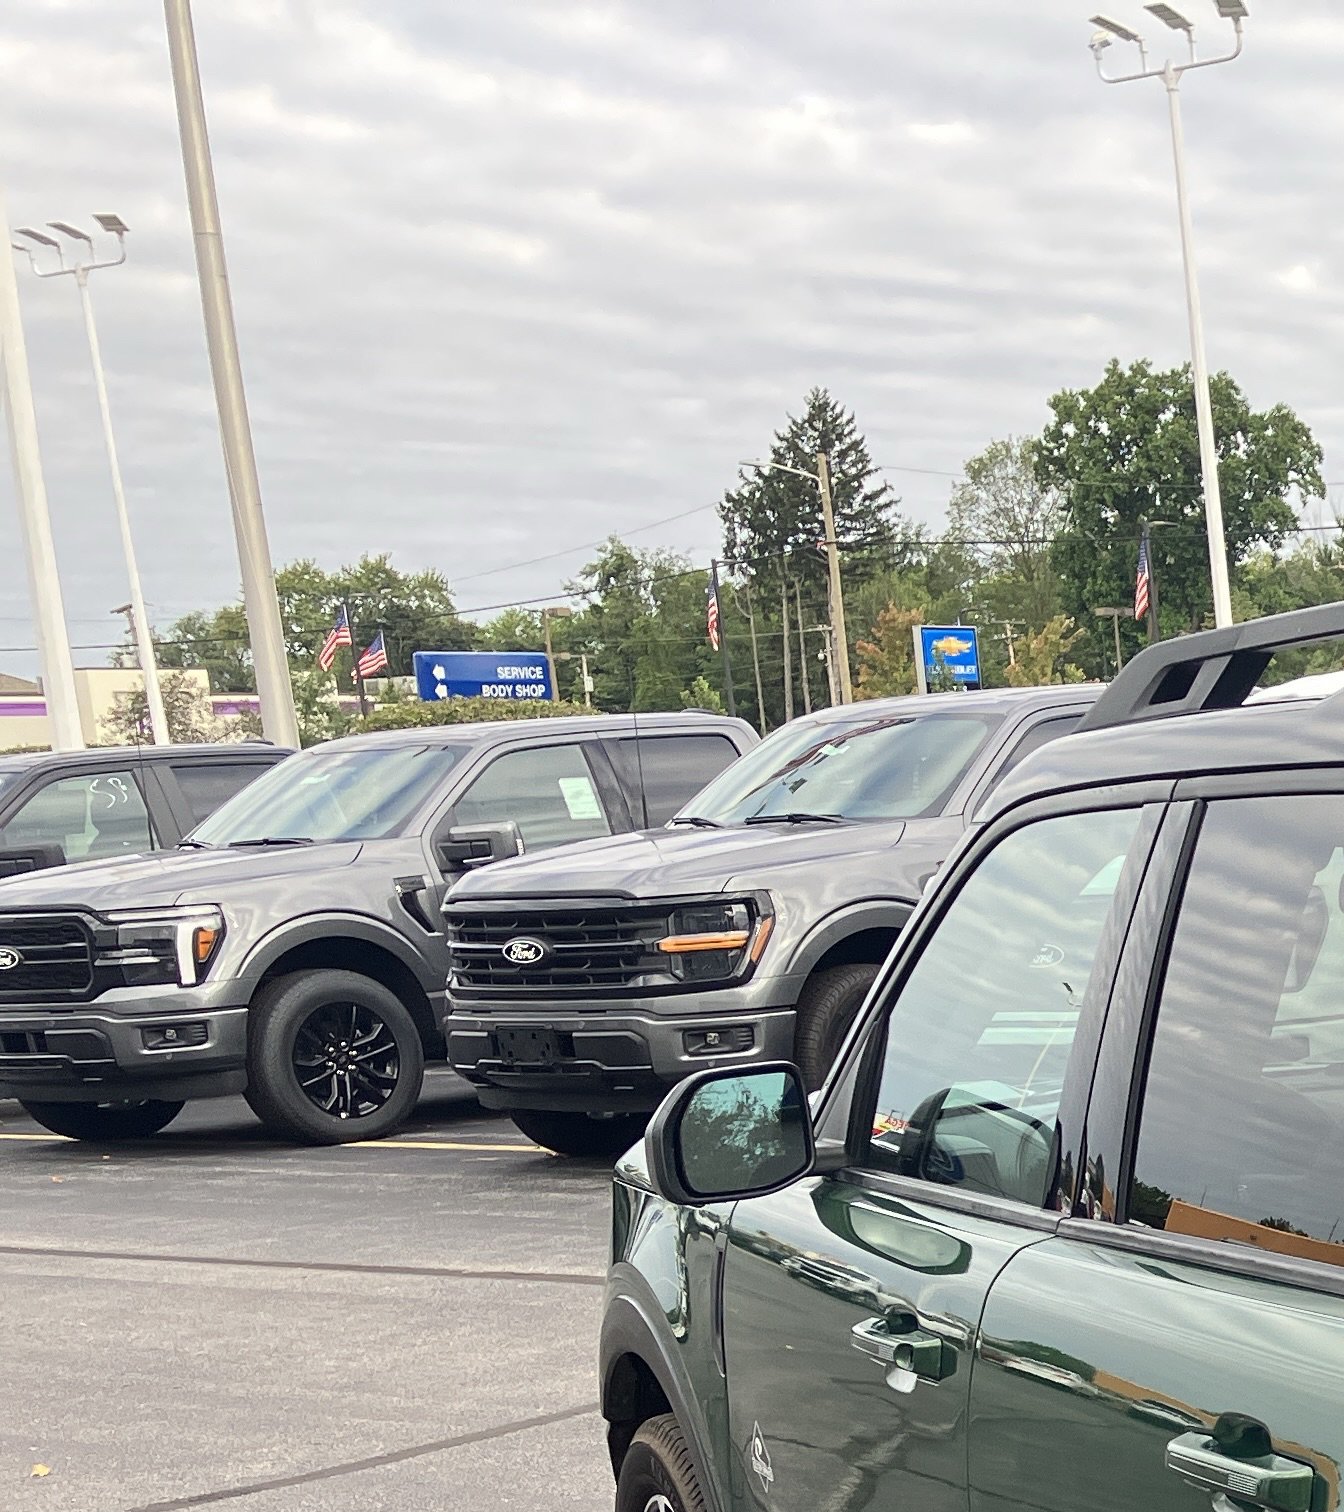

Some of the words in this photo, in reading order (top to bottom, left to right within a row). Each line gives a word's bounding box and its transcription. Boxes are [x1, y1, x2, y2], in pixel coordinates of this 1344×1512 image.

[497, 667, 543, 679] SERVICE
[482, 685, 513, 697] BODY
[515, 685, 545, 697] SHOP
[510, 943, 536, 959] Ford
